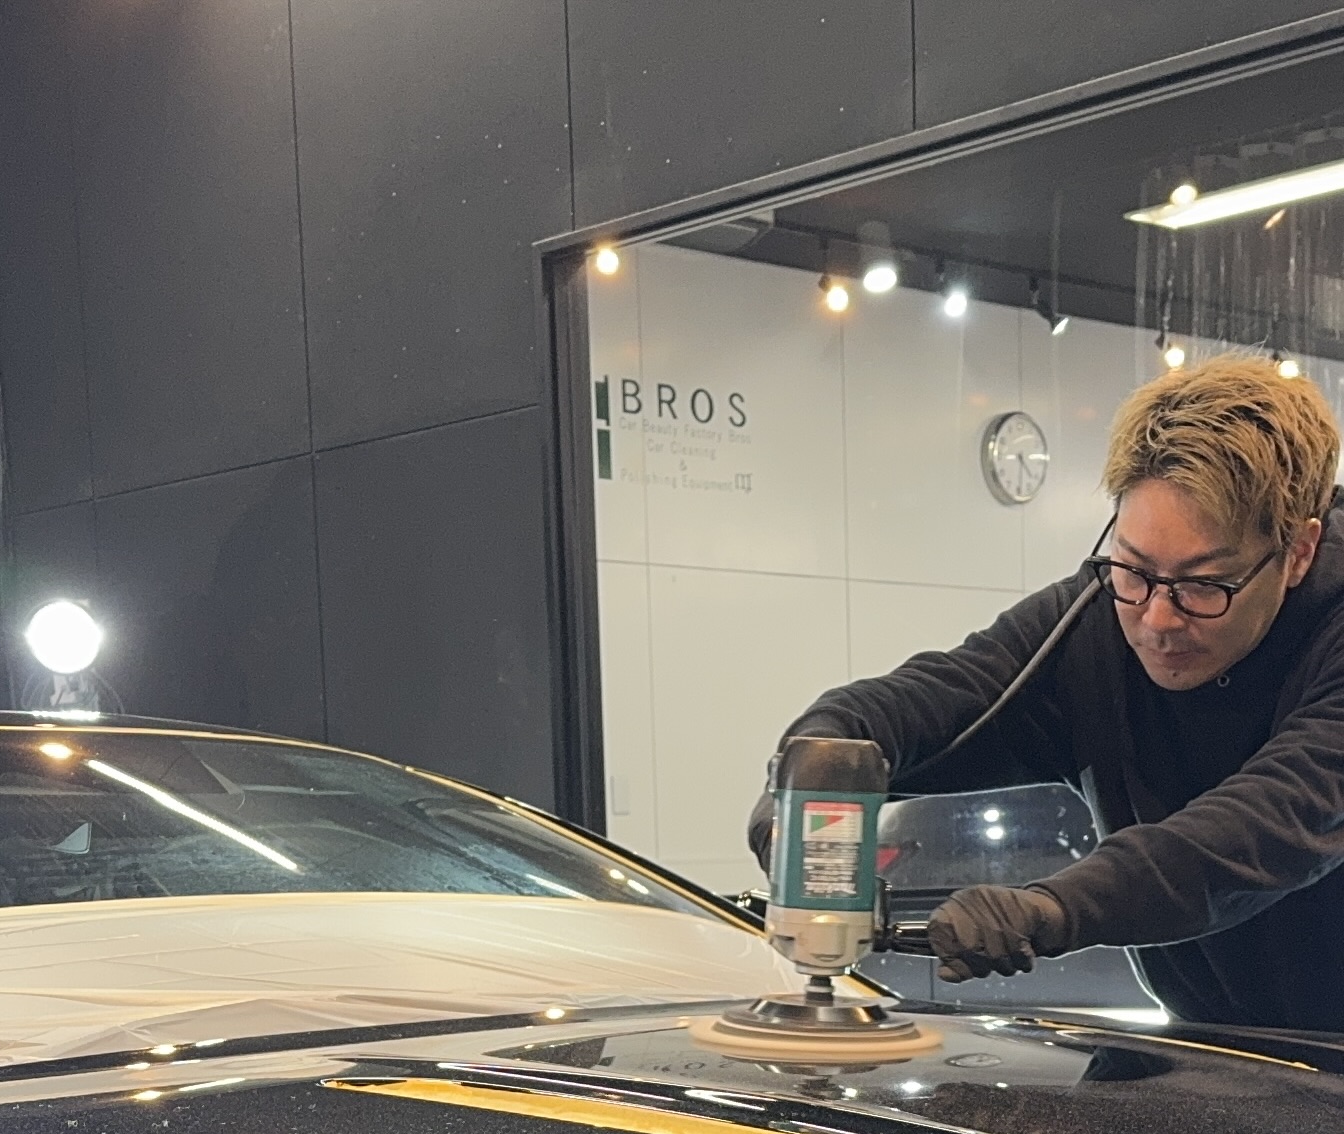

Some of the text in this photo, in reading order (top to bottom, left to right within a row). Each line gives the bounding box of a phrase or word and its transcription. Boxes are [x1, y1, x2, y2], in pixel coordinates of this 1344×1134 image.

[621, 378, 747, 428] BROS
[619, 416, 636, 430] Car
[641, 418, 678, 438] Beauty
[670, 440, 717, 461] Cleaning
